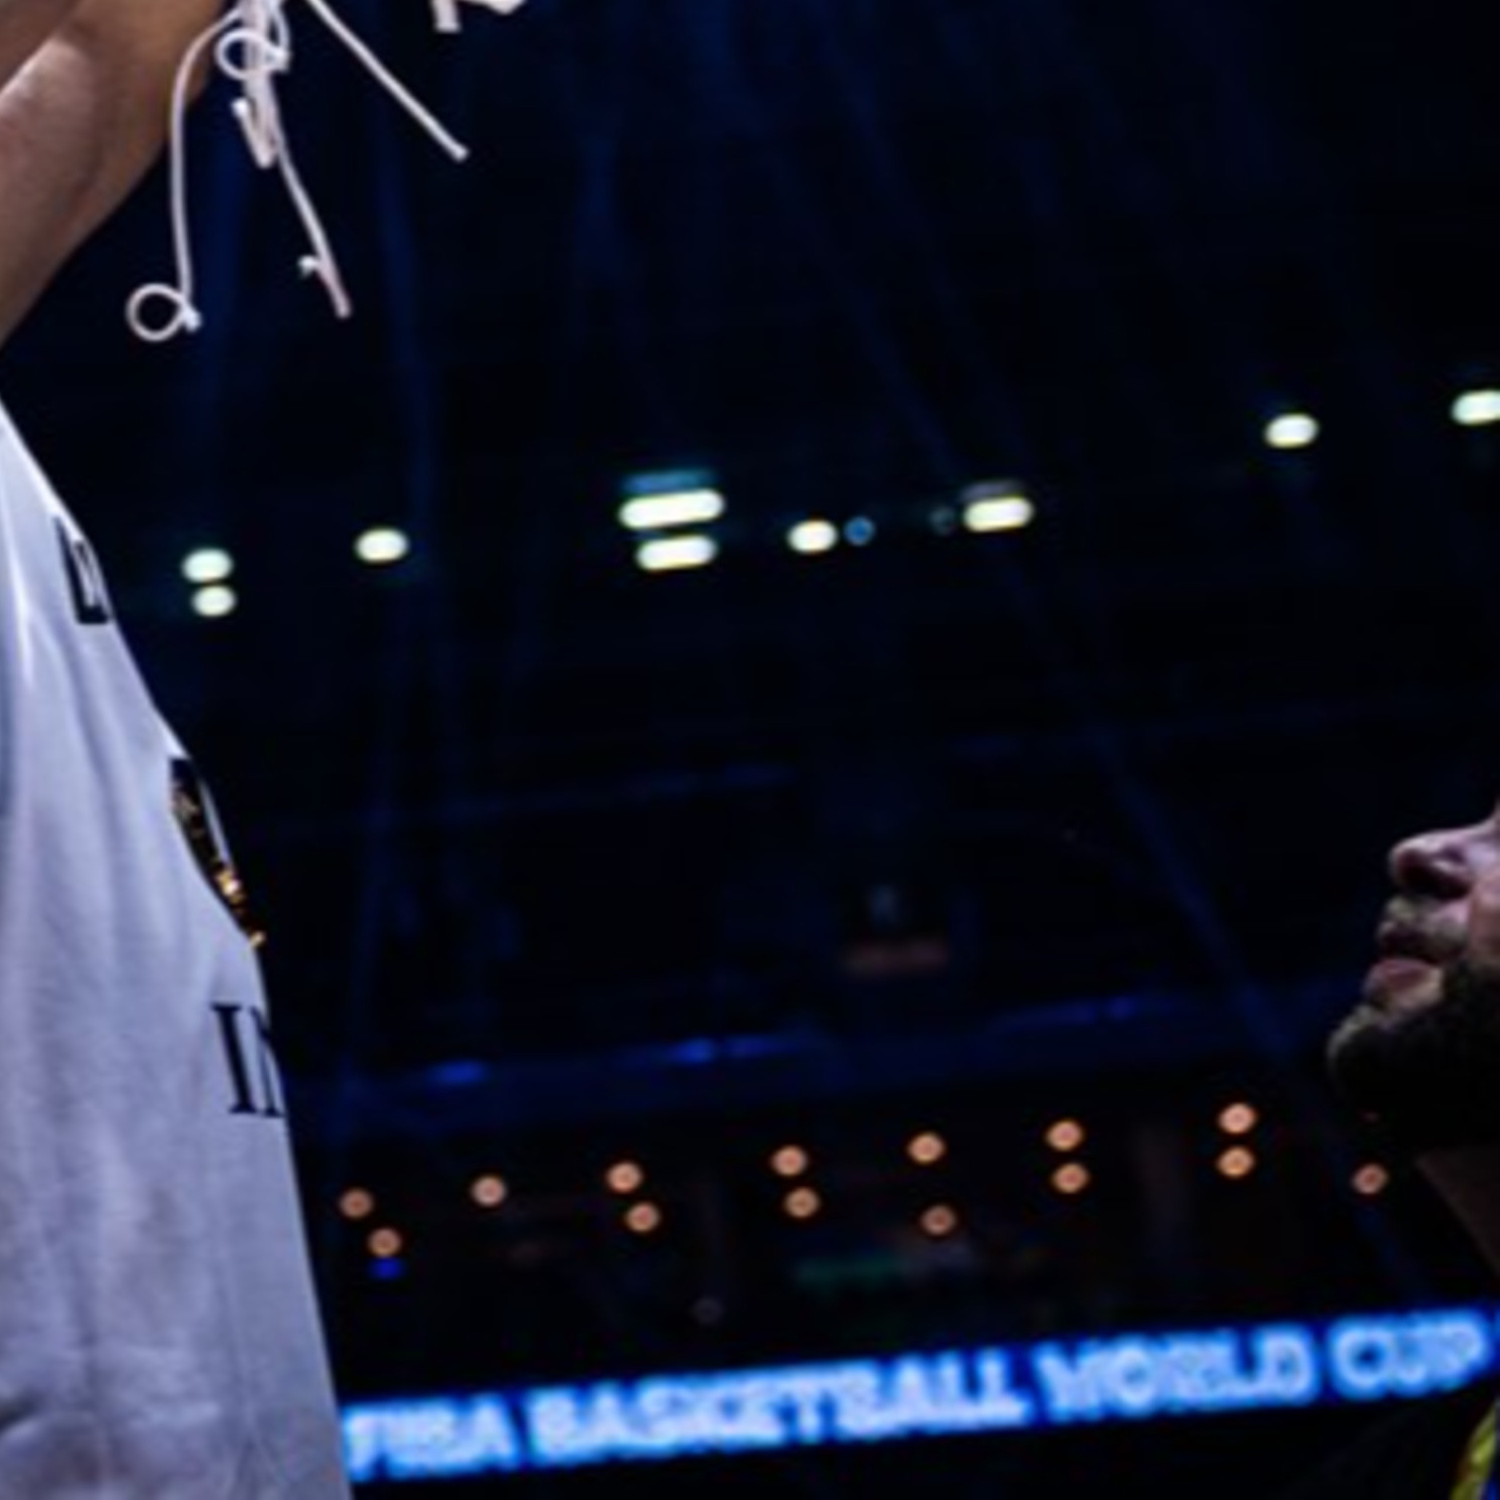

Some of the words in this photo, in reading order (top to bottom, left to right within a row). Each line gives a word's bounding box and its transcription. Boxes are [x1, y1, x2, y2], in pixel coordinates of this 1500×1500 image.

[346, 1396, 520, 1477] FIBA
[527, 1350, 1031, 1461] BASKETBALL
[1034, 1328, 1318, 1418] WORLD
[1328, 1313, 1488, 1394] CUP
